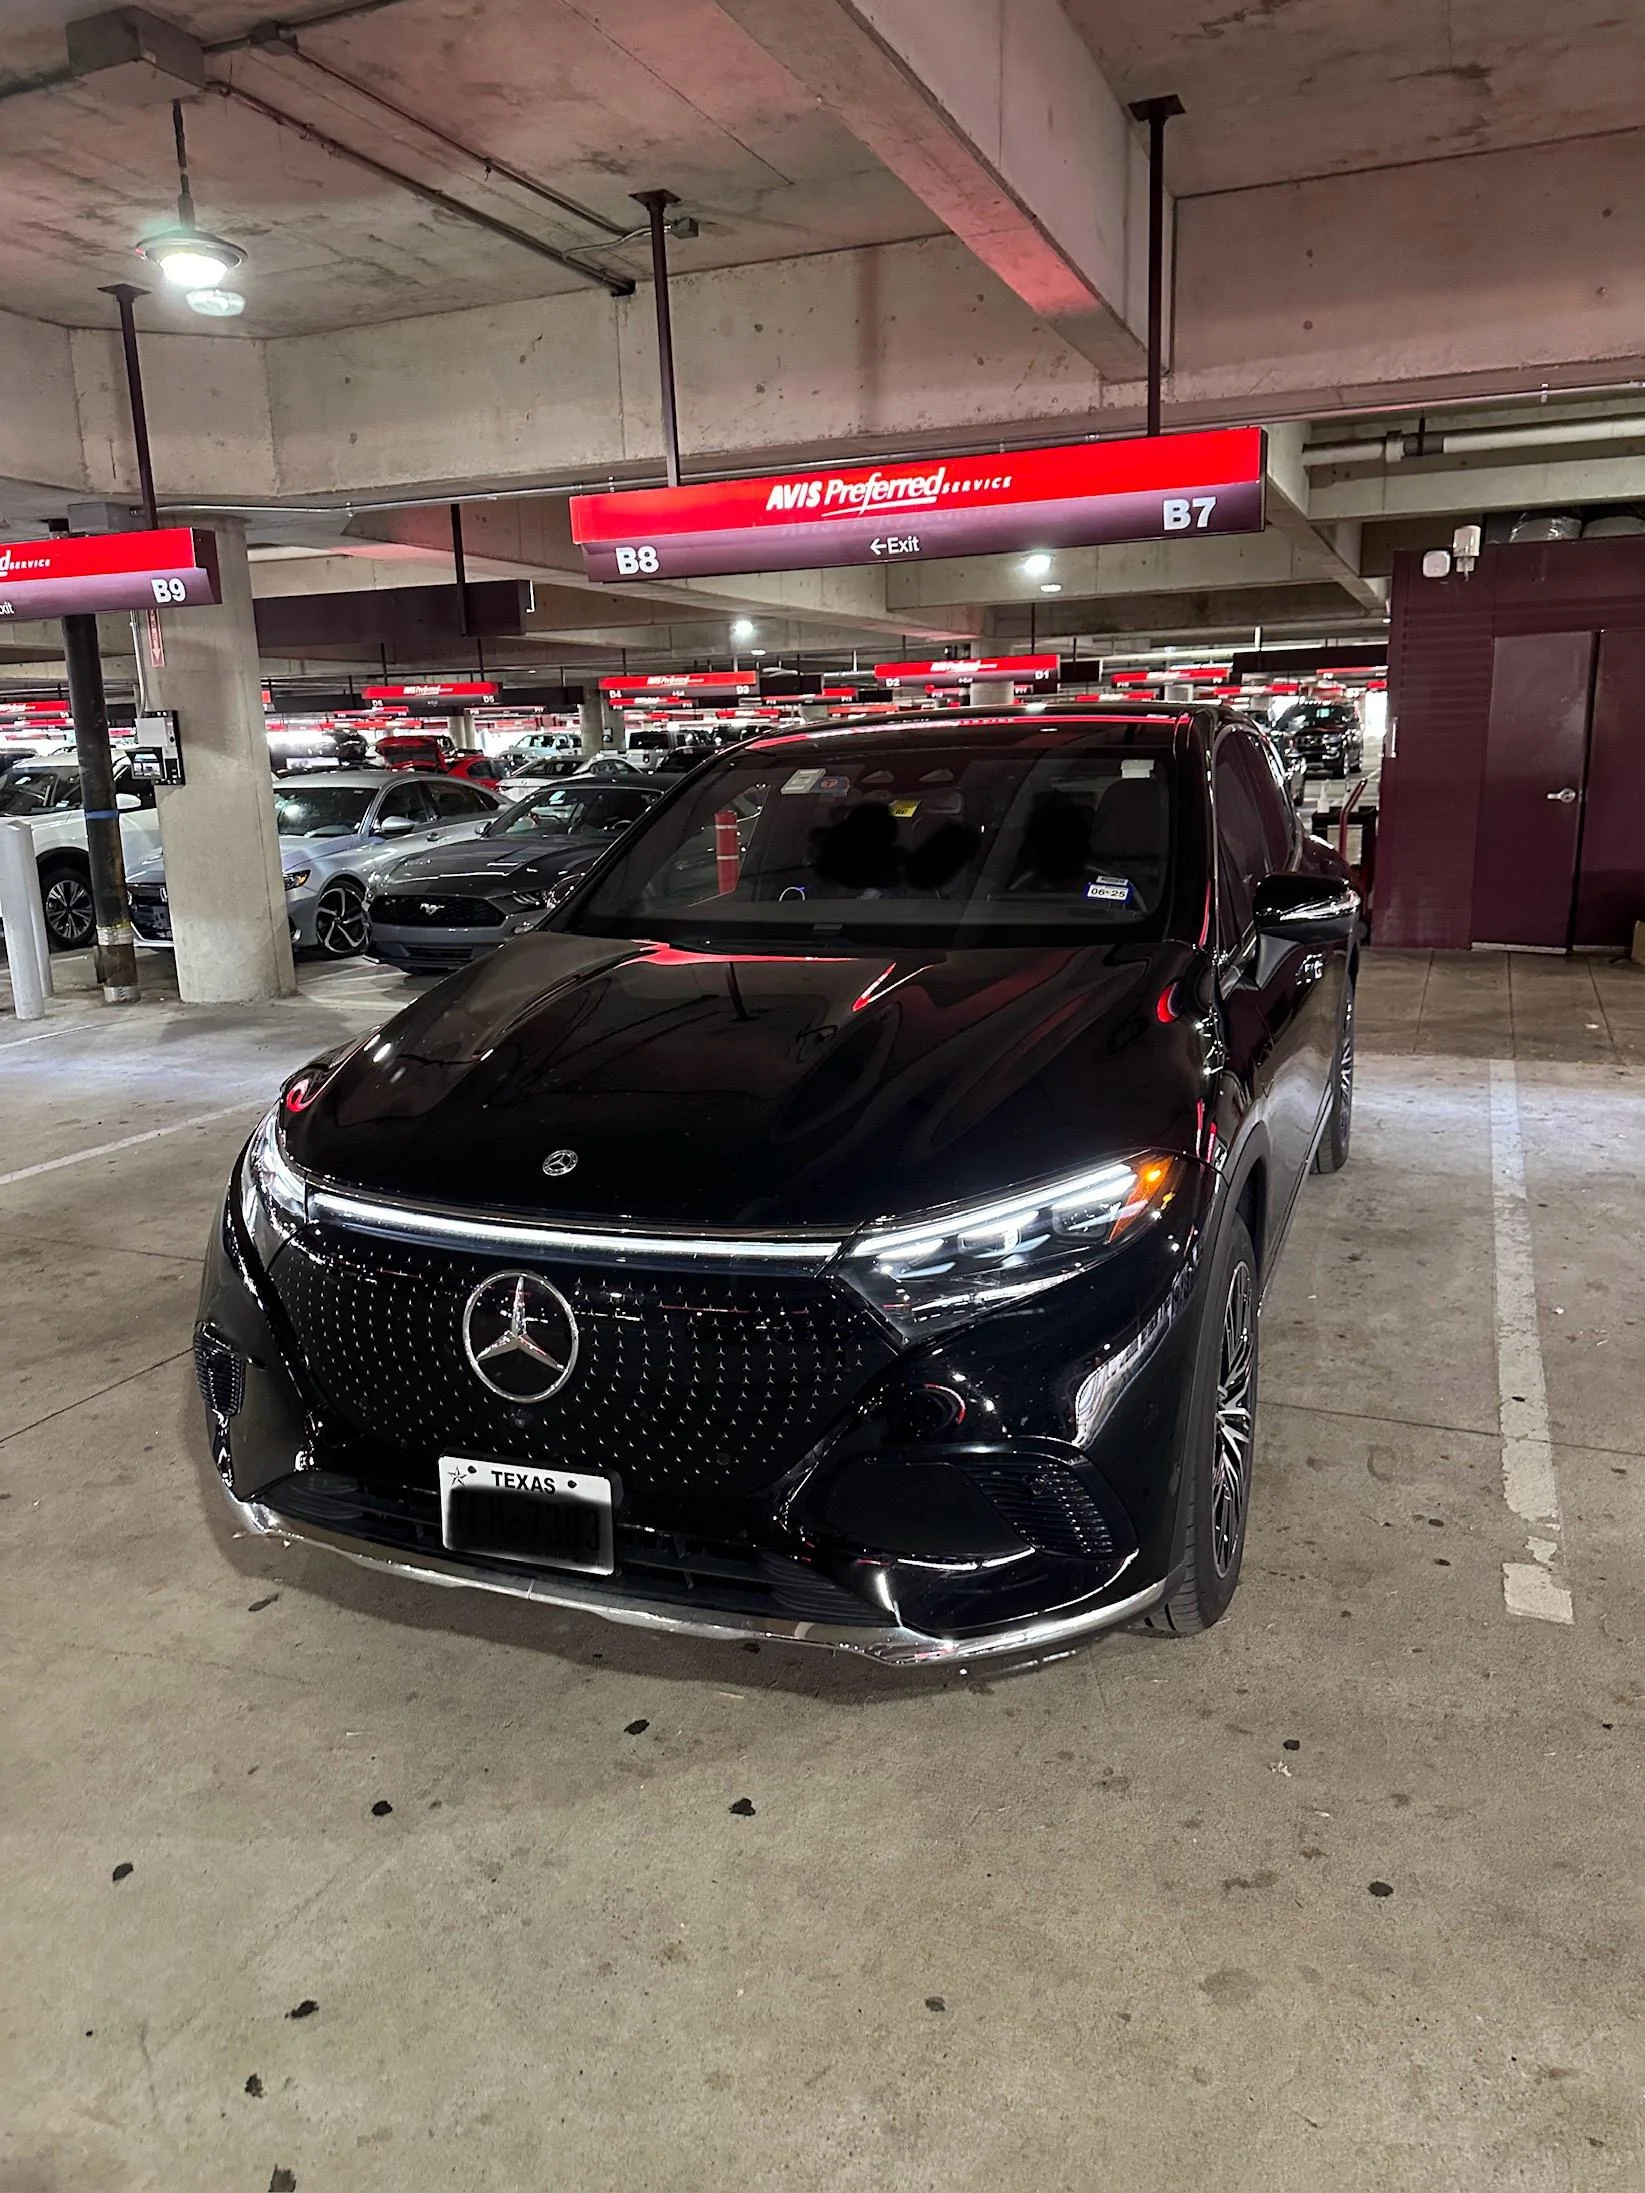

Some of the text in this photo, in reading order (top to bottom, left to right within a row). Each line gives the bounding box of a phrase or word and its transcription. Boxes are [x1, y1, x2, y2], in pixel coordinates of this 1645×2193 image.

[765, 467, 1013, 517] AVIS Preferred SERVICE
[1163, 497, 1217, 531] B7
[888, 535, 920, 554] Exit
[9, 559, 51, 570] SERVICE
[616, 546, 660, 575] B8
[151, 577, 187, 604] B9
[0, 602, 14, 615] xit
[491, 1471, 556, 1495] TEXAS
